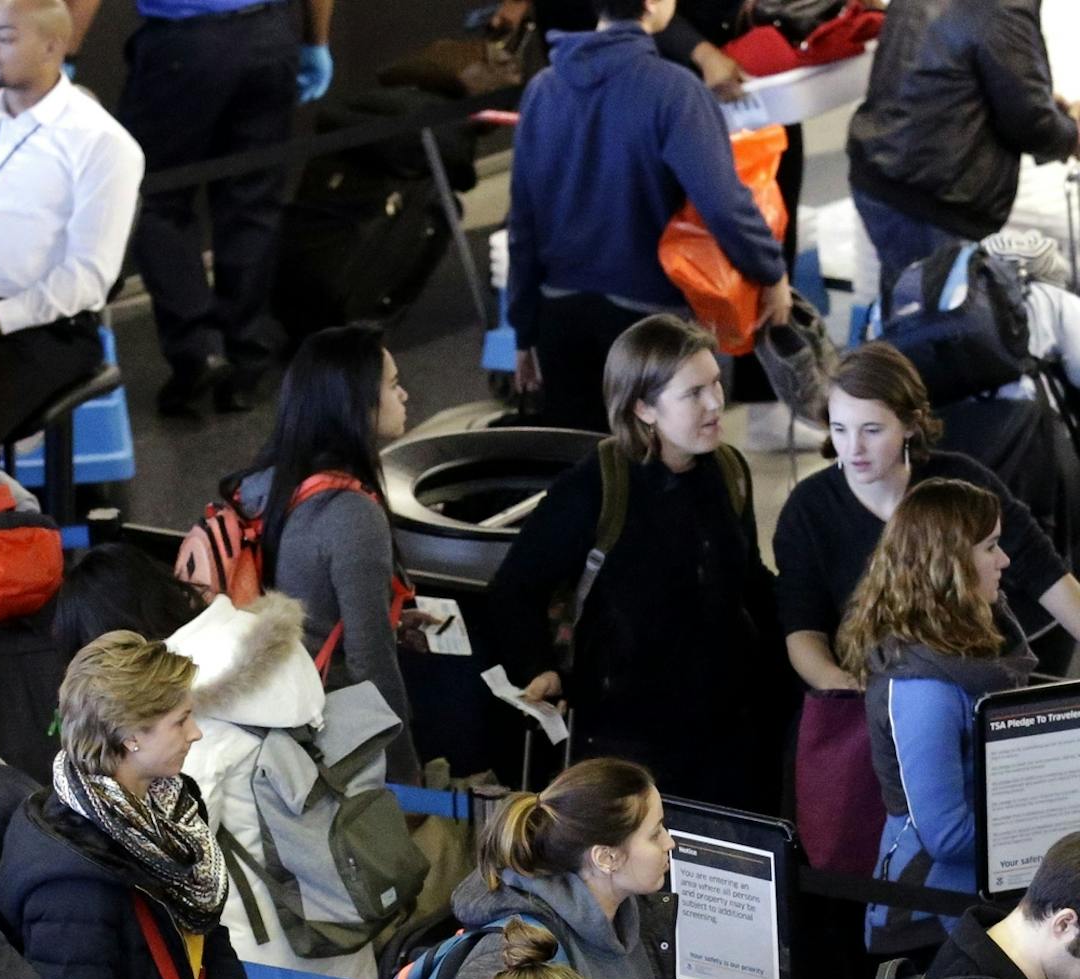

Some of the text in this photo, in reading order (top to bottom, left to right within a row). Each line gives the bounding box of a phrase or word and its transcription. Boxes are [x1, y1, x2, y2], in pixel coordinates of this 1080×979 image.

[990, 720, 1007, 731] TSA
[1007, 717, 1035, 729] Pledge
[1036, 714, 1047, 724] To
[1000, 859, 1019, 869] Your
[680, 869, 750, 891] You are entering an
[681, 880, 697, 889] area
[698, 884, 721, 895] where
[732, 891, 760, 903] persons
[681, 889, 756, 912] and property may be
[681, 899, 754, 921] subject to additional
